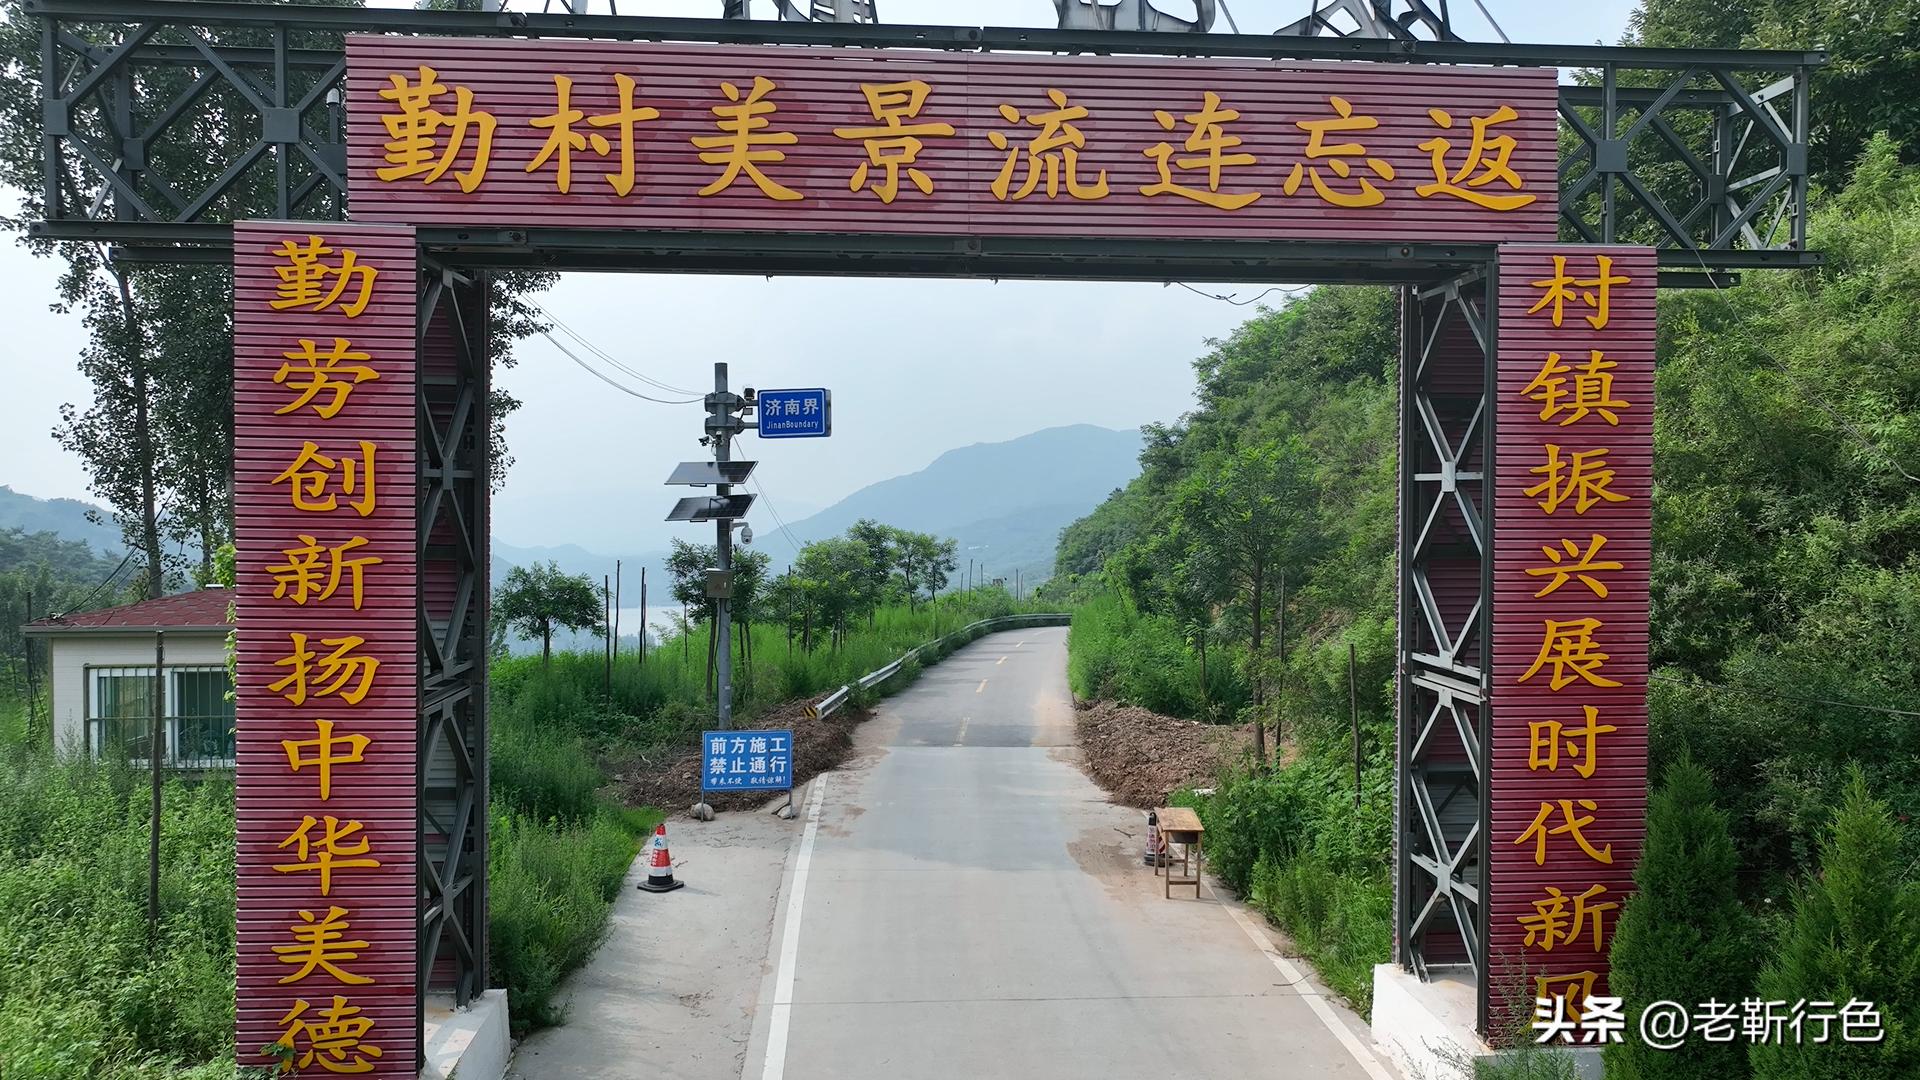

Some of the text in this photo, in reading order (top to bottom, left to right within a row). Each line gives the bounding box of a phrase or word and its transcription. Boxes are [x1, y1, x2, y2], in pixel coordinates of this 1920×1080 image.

[375, 67, 1537, 211] 勤村美景流连忘返
[765, 398, 819, 416] 济南界
[766, 420, 819, 430] JinanBoundary
[261, 235, 384, 1074] 勤劳创新扬中华美德
[710, 737, 787, 755] 前方施工
[710, 756, 787, 774] 禁止通行
